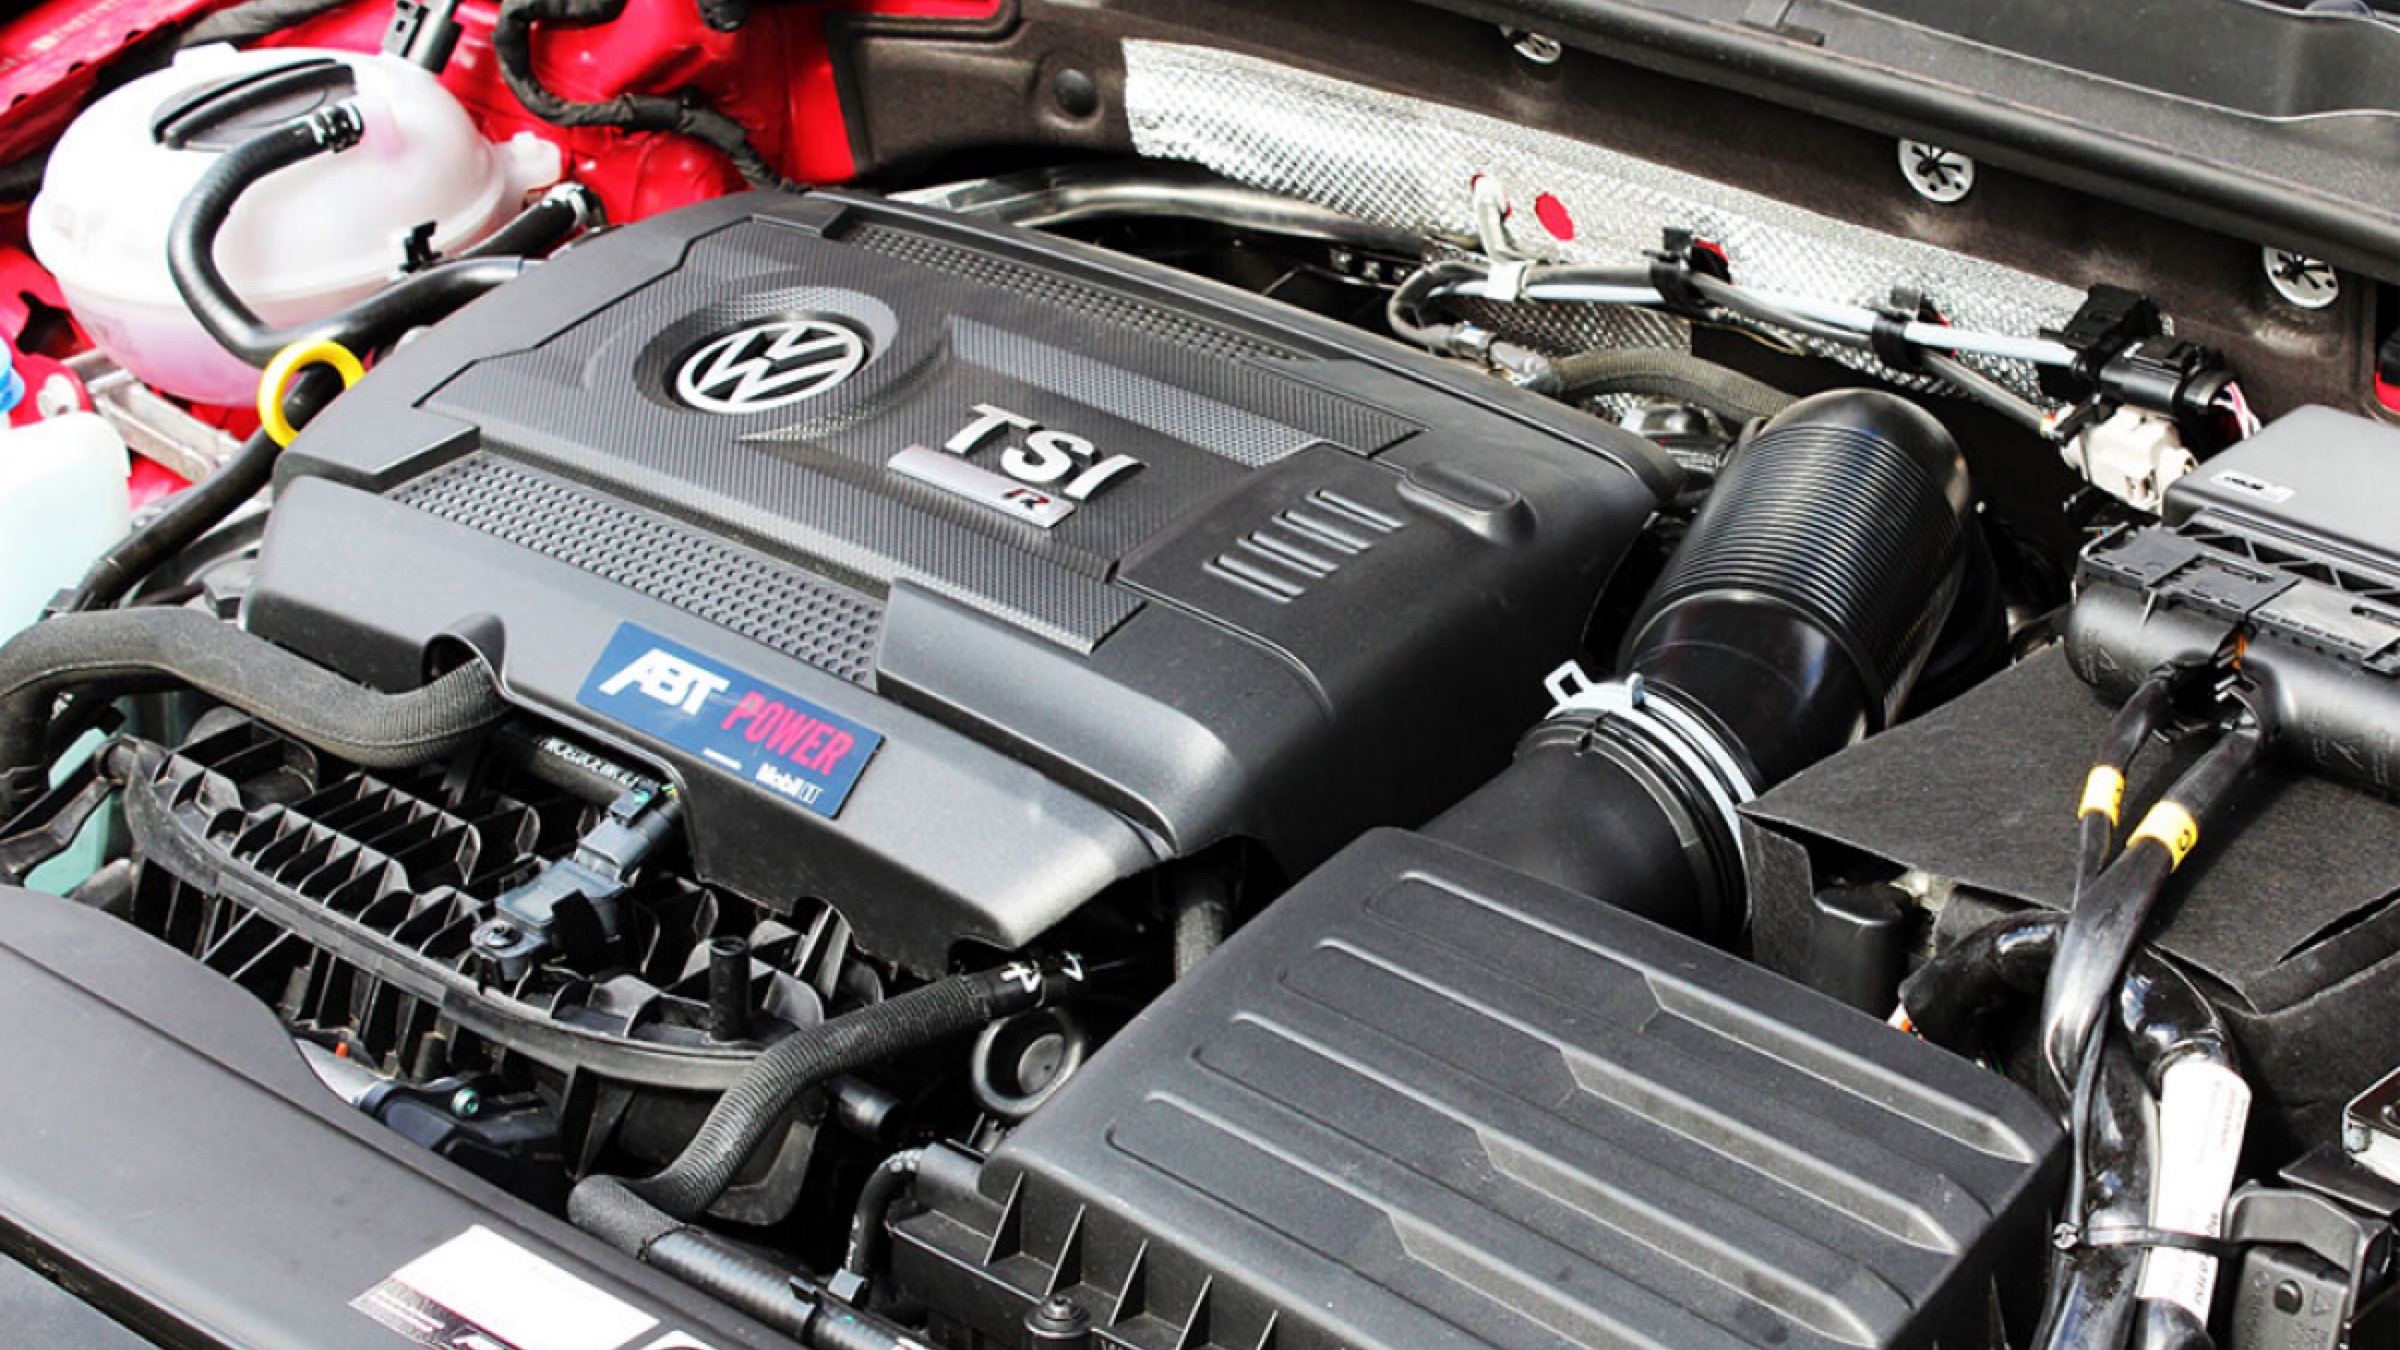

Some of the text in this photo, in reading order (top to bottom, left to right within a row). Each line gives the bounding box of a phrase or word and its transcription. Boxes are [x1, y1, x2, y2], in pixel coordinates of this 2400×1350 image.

[945, 404, 1142, 499] TSI
[1005, 489, 1050, 511] R
[598, 649, 731, 716] ABT
[722, 691, 855, 775] POWER
